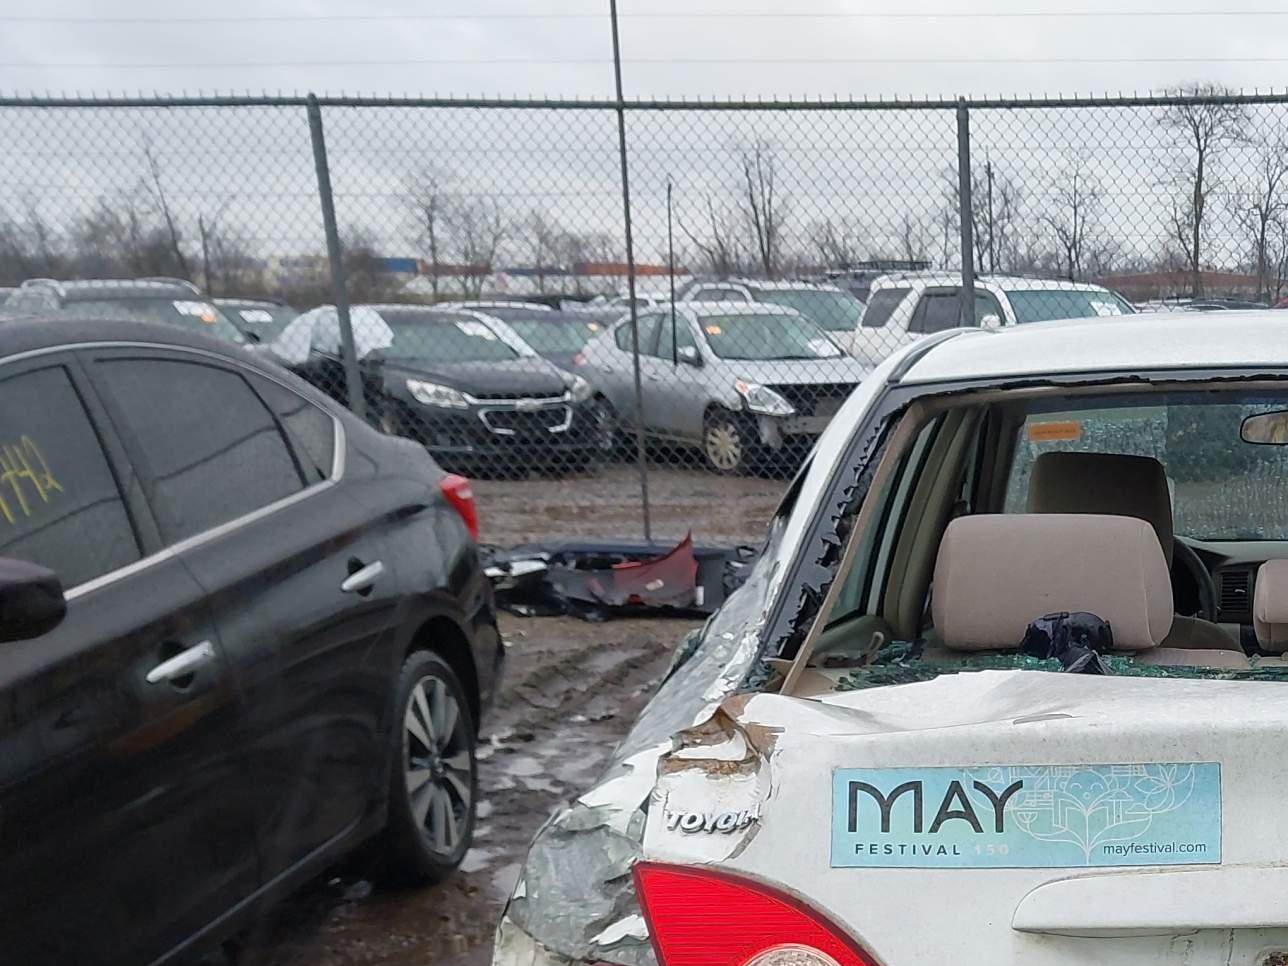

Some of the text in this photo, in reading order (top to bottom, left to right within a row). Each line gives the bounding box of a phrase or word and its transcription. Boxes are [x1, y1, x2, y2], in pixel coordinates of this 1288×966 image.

[847, 780, 1024, 834] MAY
[855, 842, 961, 856] FESTIVAL
[1103, 841, 1206, 857] mayfestival.com
